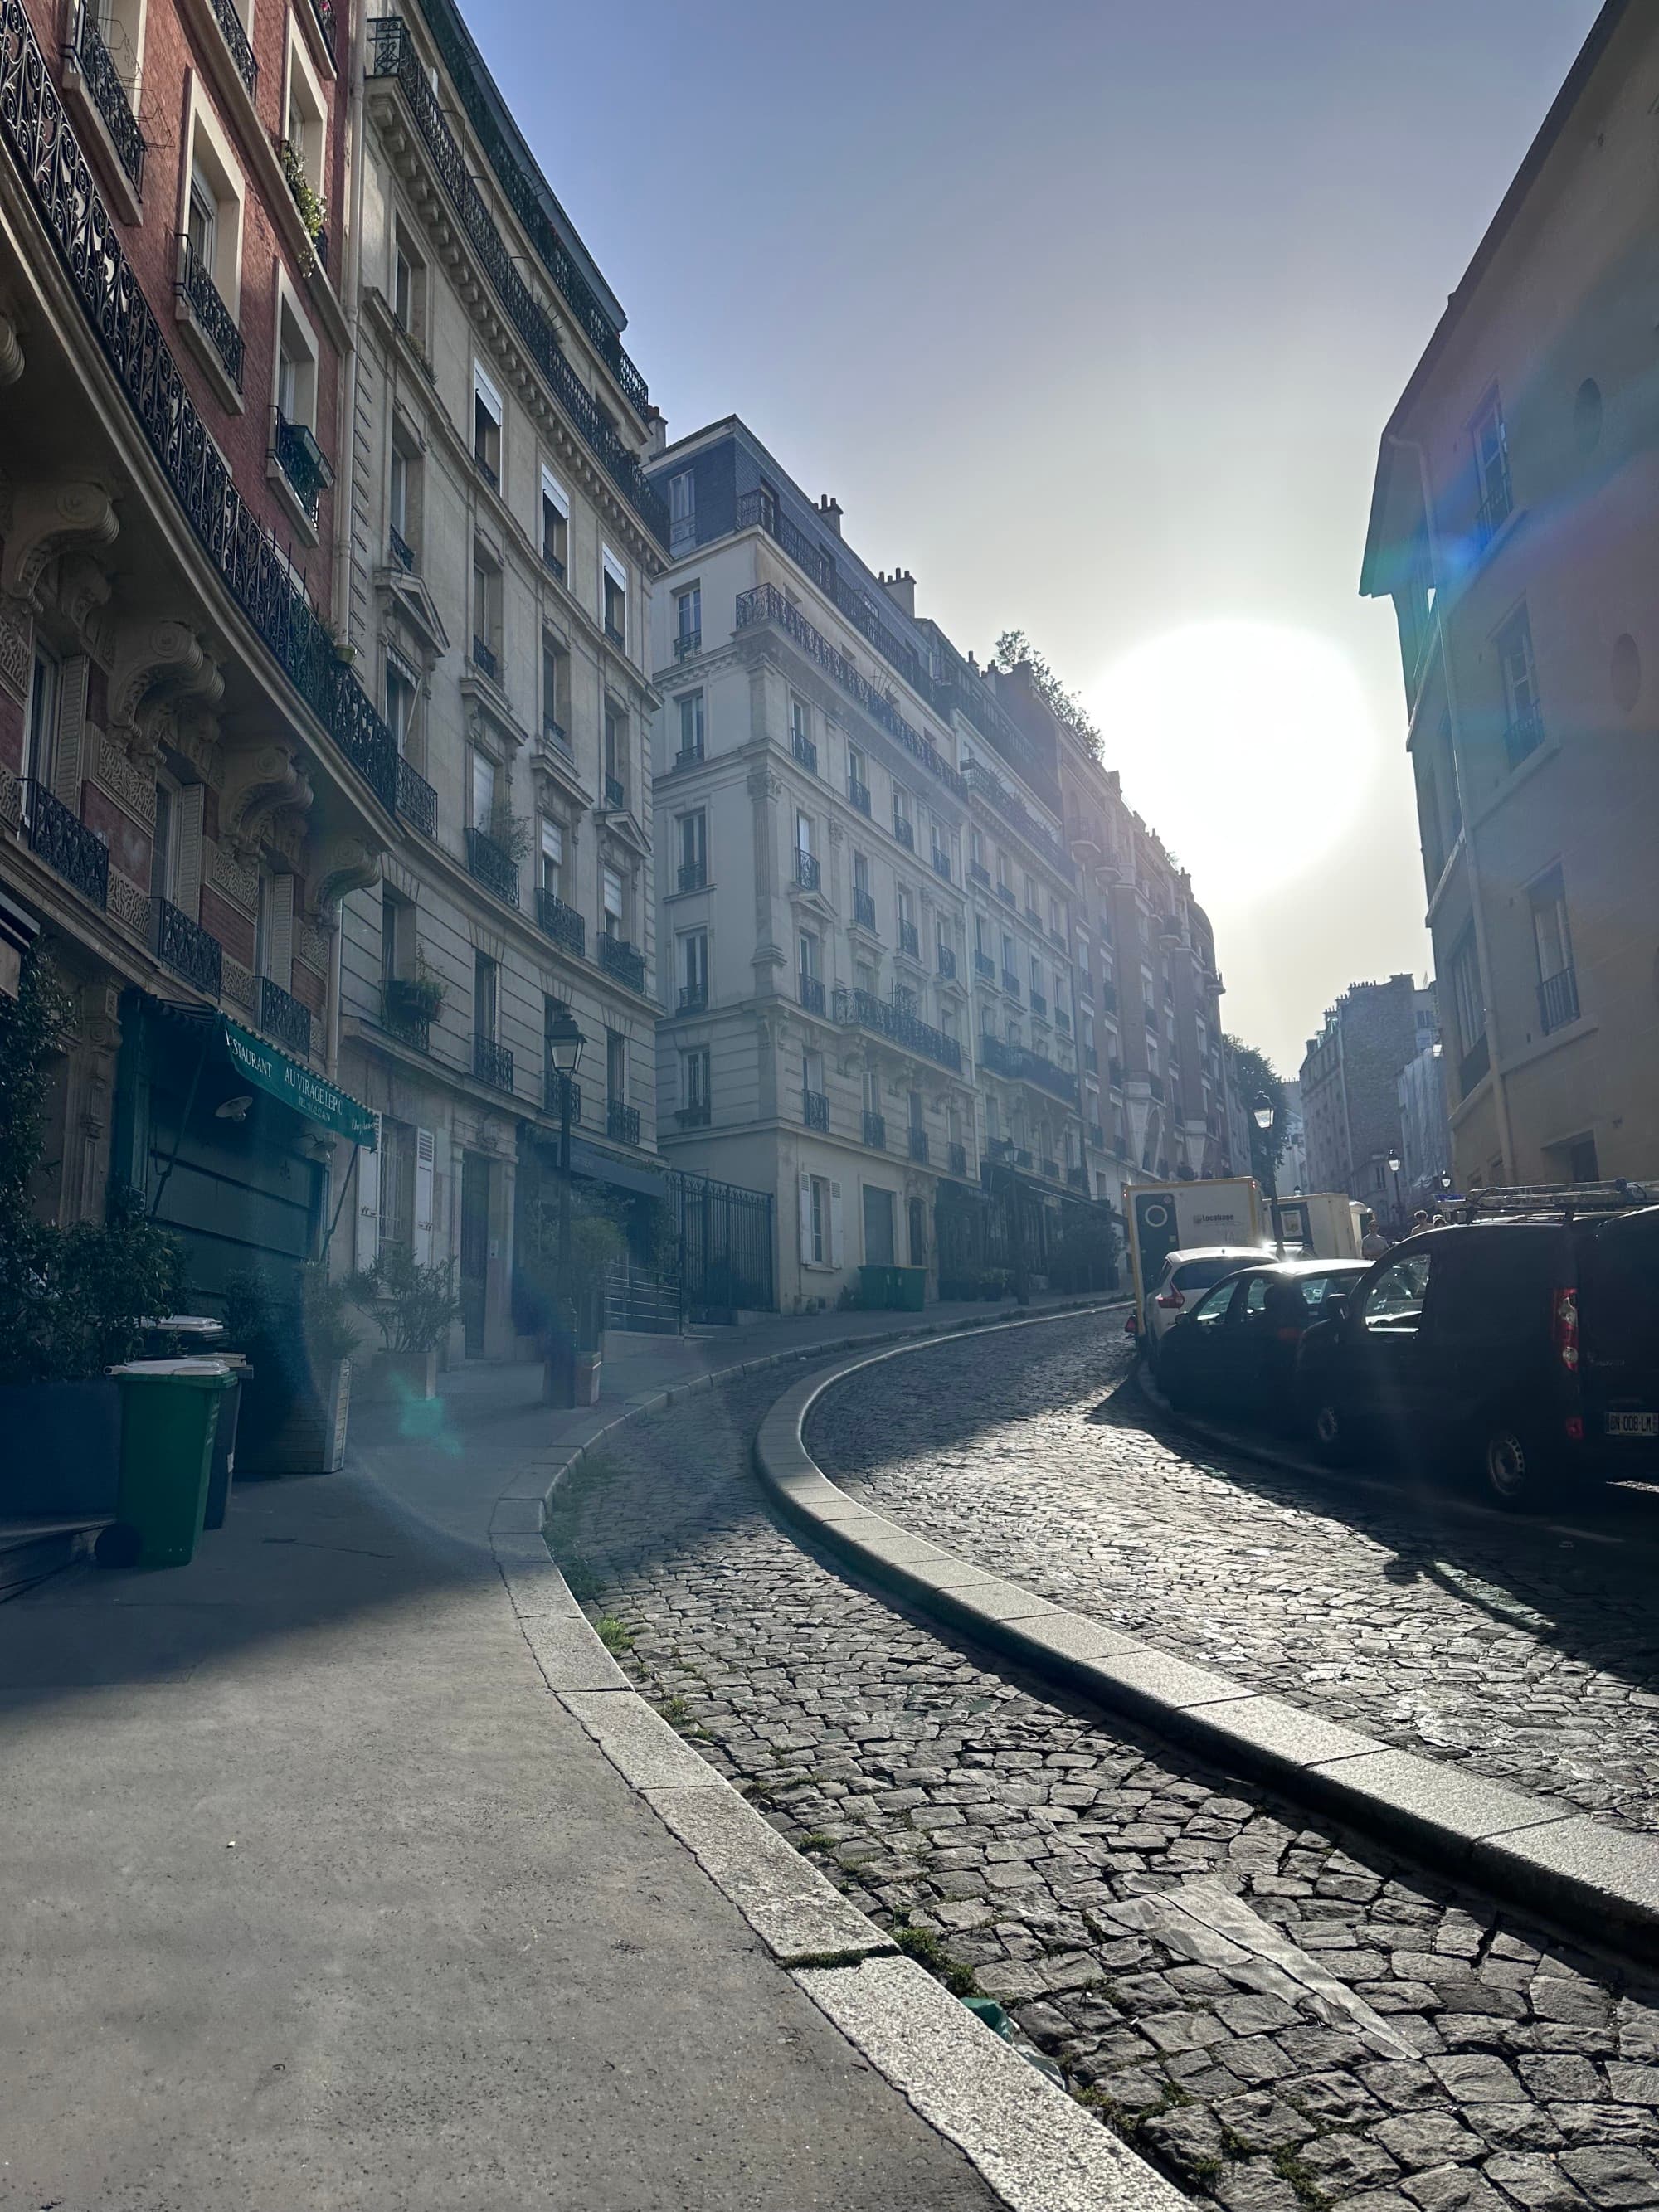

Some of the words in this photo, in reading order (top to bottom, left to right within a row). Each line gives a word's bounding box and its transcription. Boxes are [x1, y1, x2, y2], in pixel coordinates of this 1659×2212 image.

[225, 1028, 273, 1078] STAURANT
[285, 1067, 296, 1087] AU
[296, 1073, 324, 1105] VIRAGE
[324, 1091, 343, 1116] LEPIC
